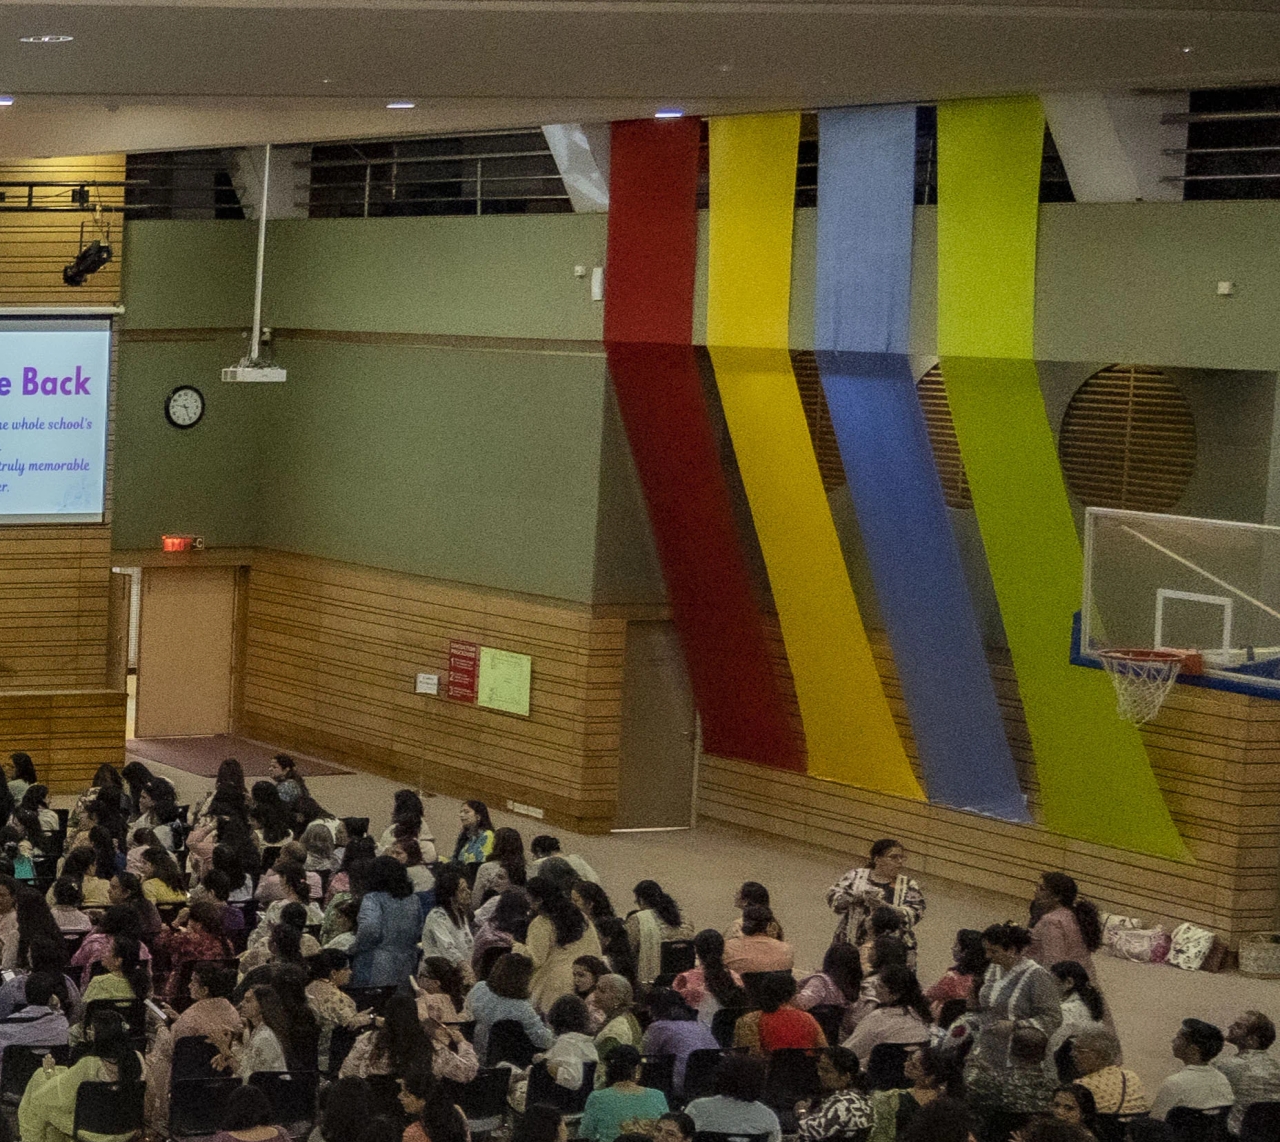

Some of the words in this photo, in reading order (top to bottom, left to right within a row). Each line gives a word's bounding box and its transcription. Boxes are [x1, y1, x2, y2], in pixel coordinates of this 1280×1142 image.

[22, 365, 91, 396] Back
[11, 417, 44, 430] whole
[48, 417, 92, 429] school's
[28, 458, 89, 471] memorable
